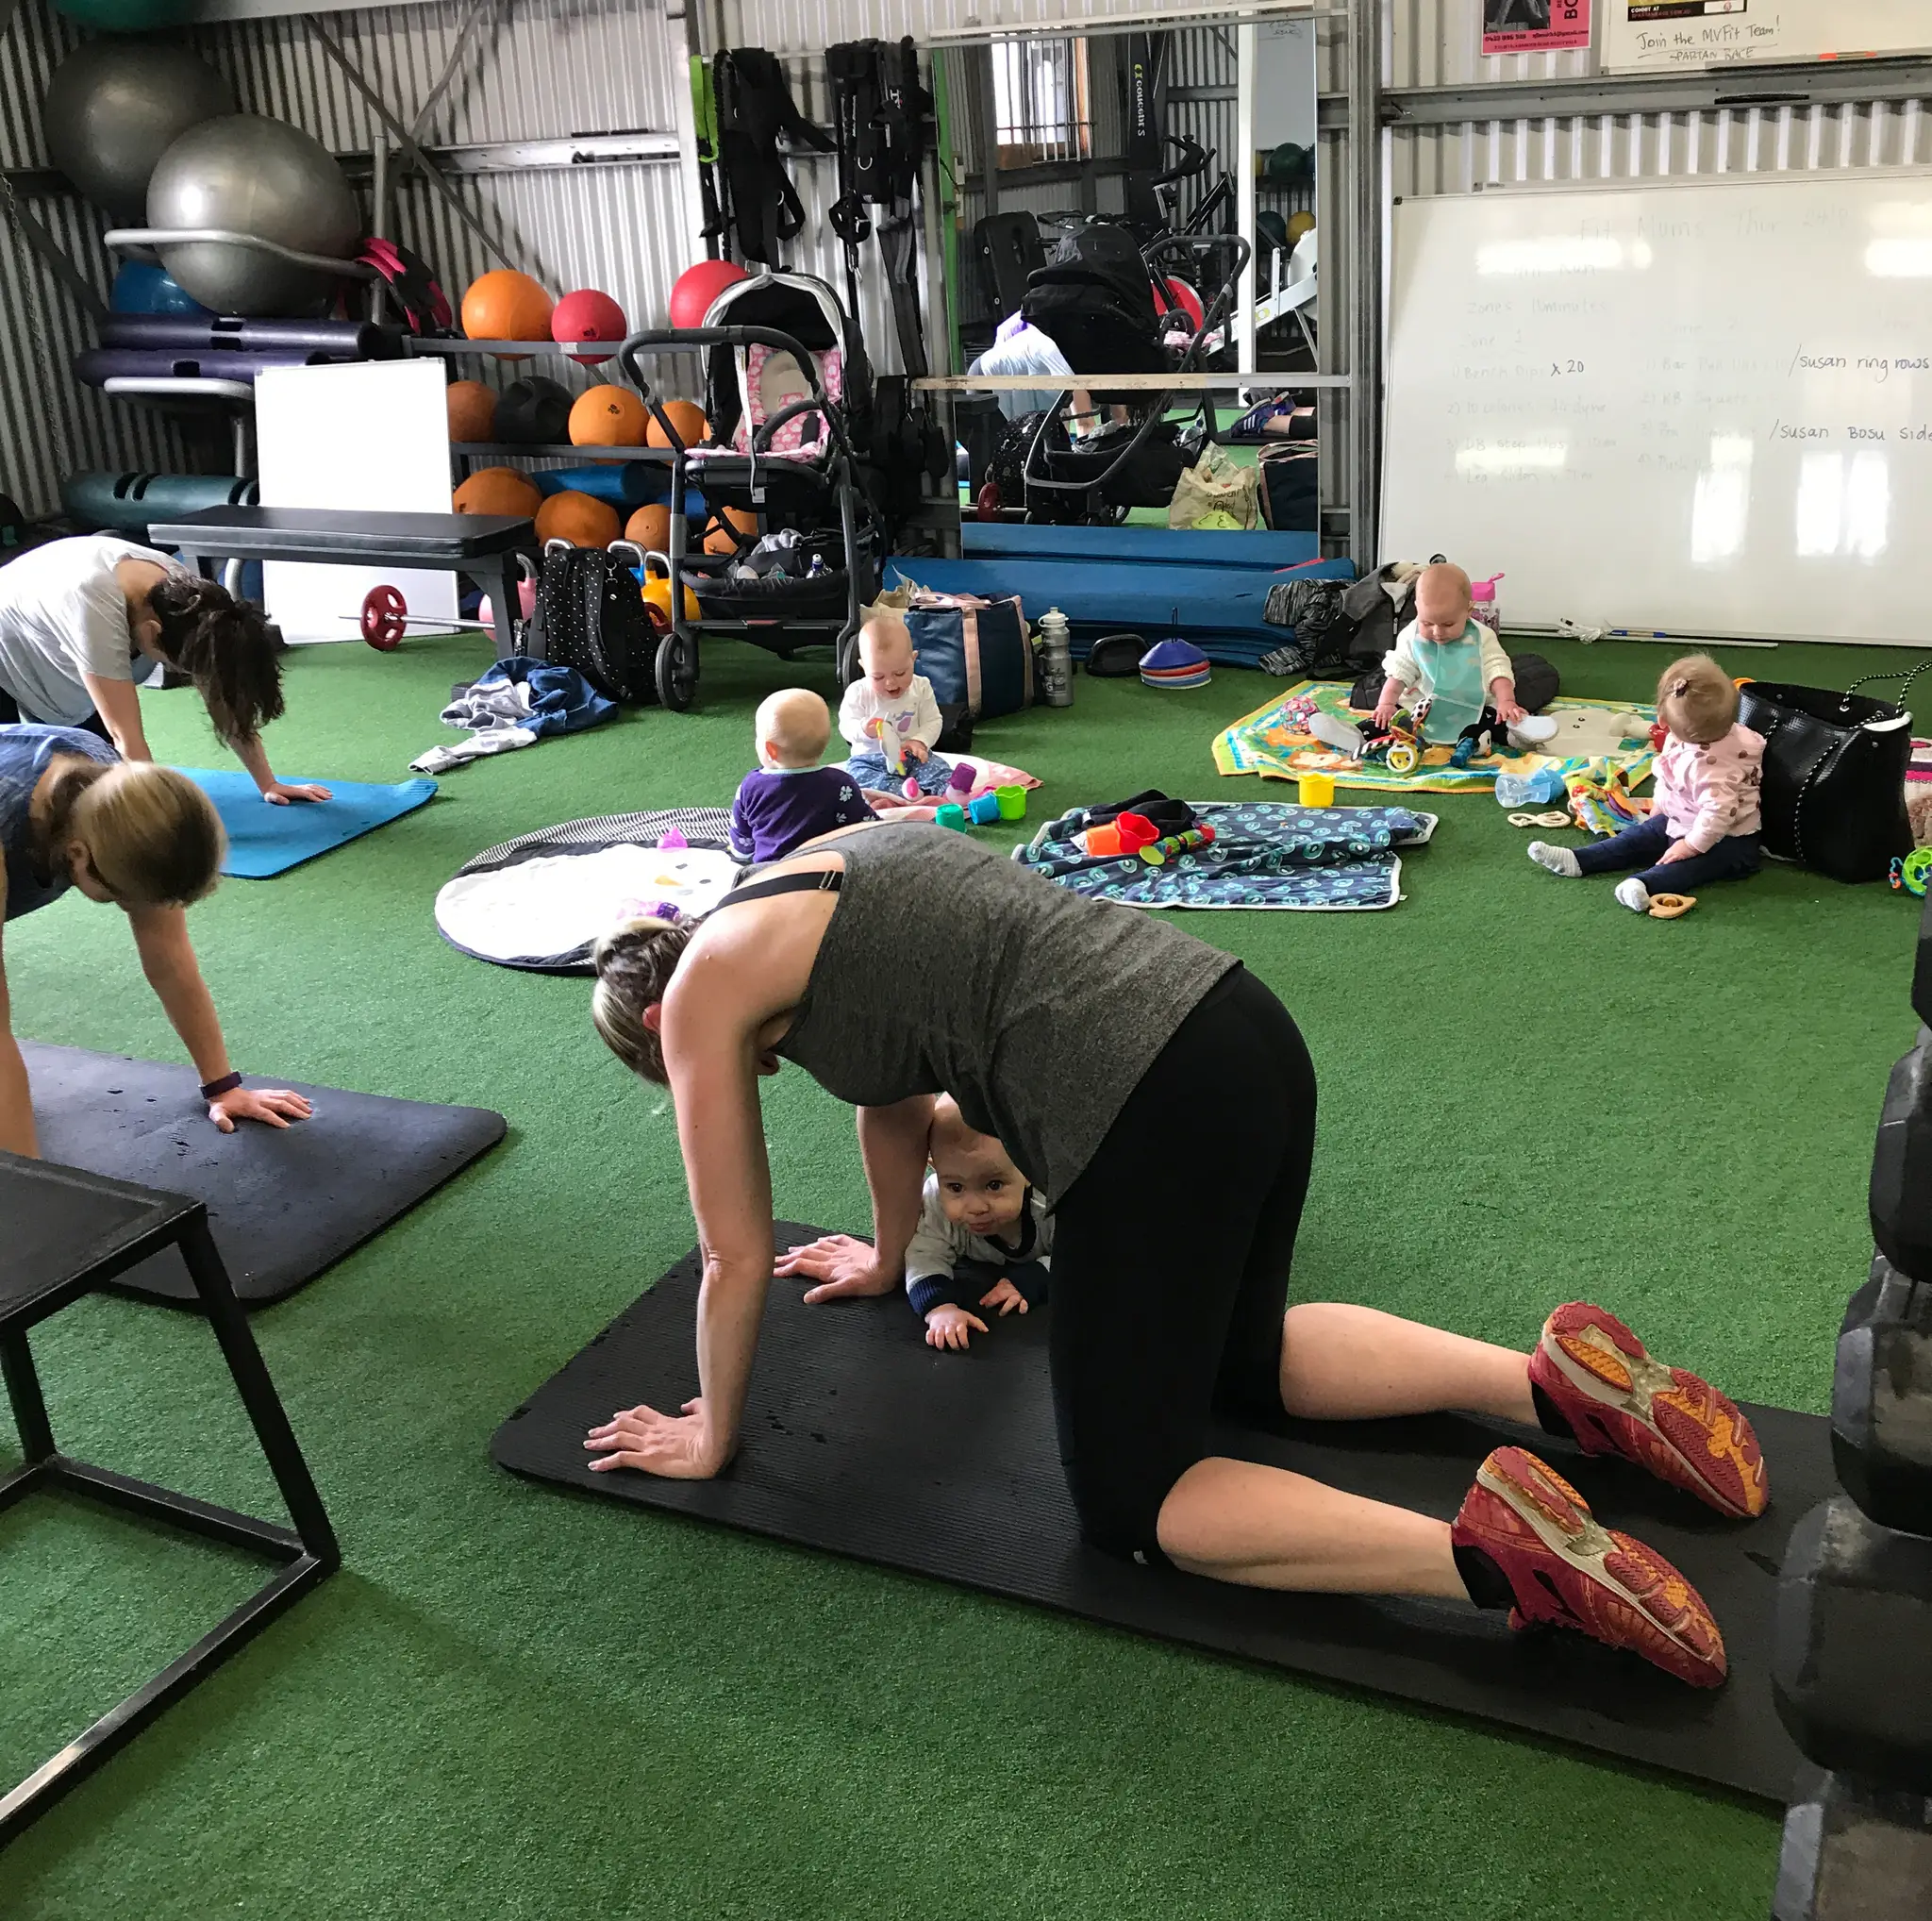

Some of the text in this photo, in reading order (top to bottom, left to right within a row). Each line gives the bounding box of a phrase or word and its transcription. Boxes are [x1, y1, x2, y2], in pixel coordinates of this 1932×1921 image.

[1636, 14, 1781, 50] Join the MVFit Team!
[1566, 359, 1585, 374] 20
[1857, 357, 1888, 383] ring
[1895, 358, 1929, 369] rows
